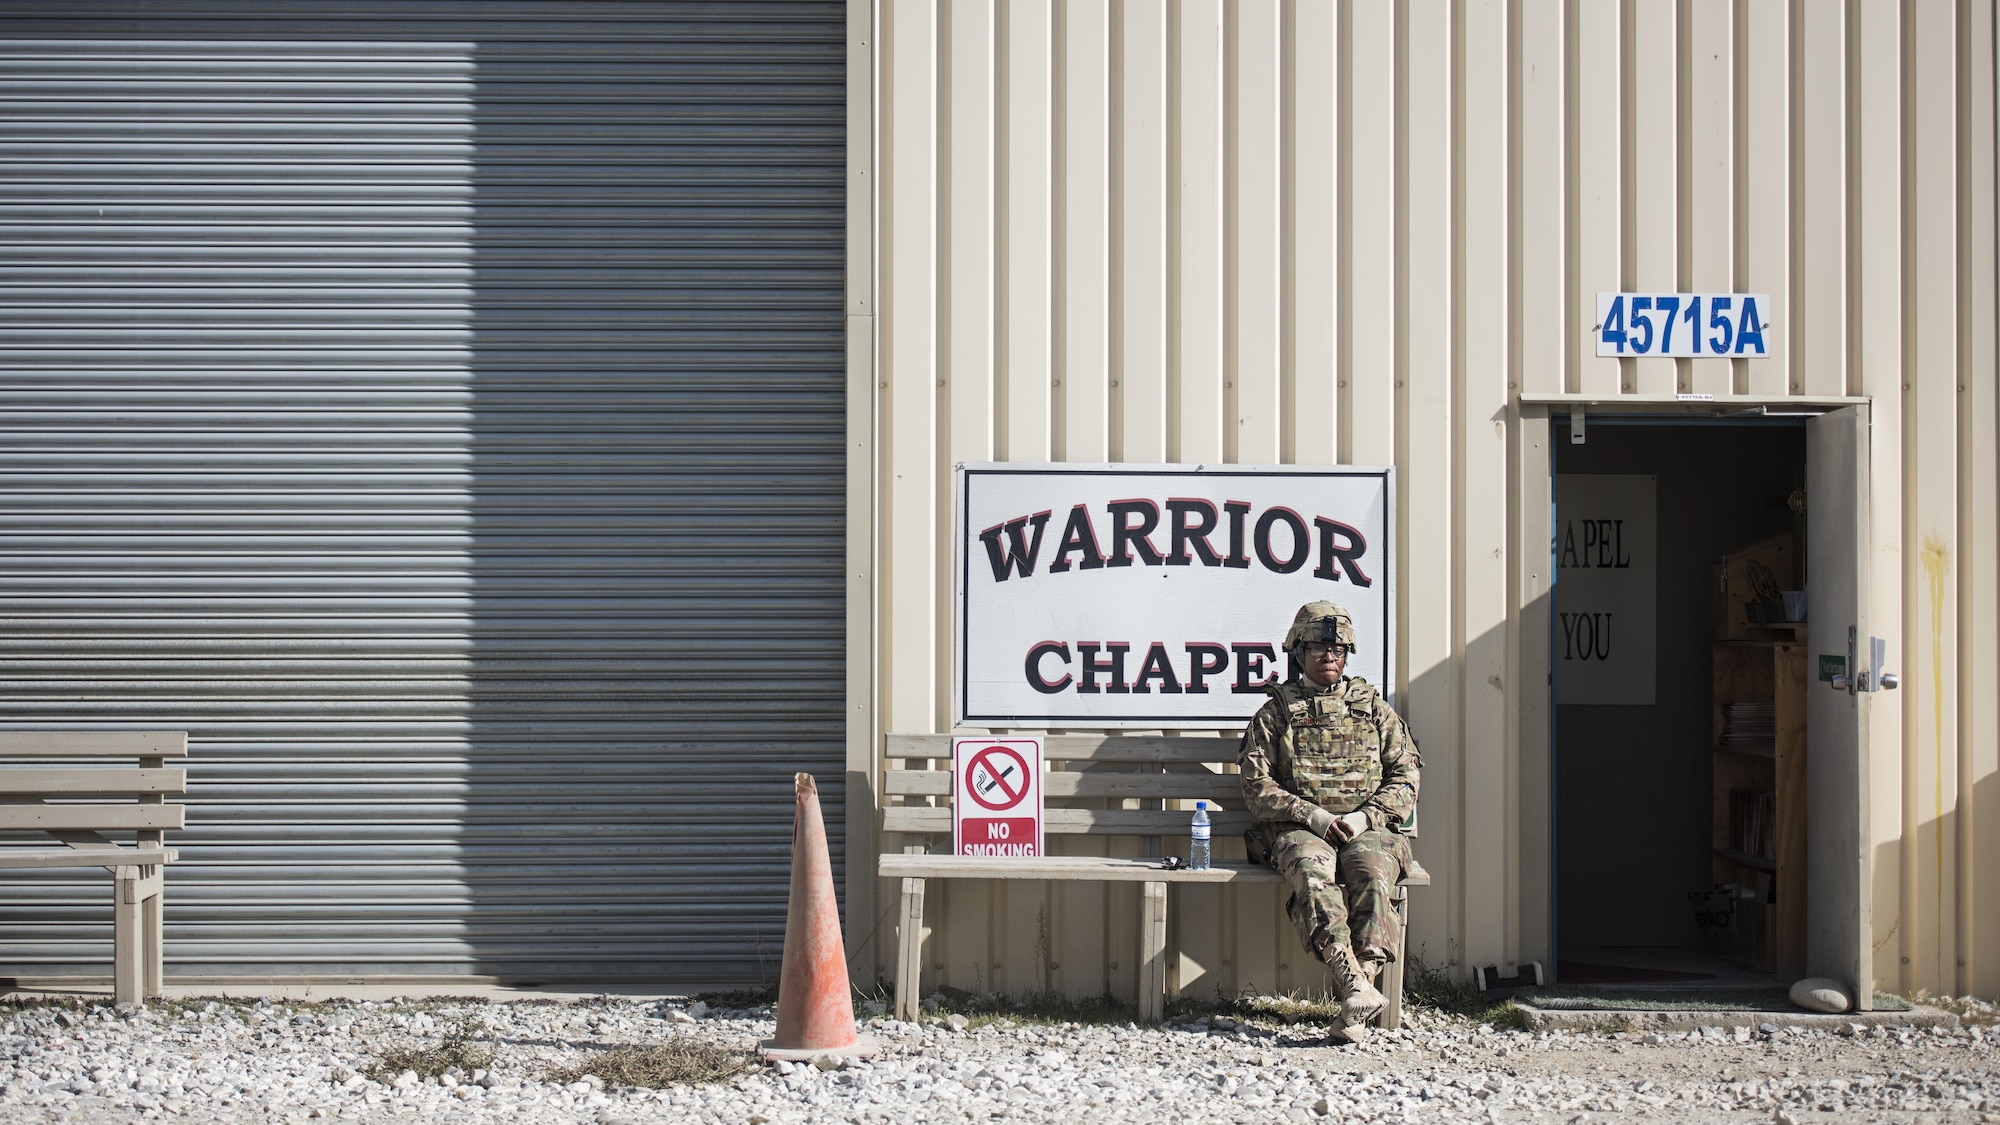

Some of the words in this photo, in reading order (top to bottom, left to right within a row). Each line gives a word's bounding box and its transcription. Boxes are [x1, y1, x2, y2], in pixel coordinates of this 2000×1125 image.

[1602, 296, 1765, 354] 45715A
[979, 497, 1373, 588] WARRIOR
[1556, 519, 1631, 569] APEL
[1559, 612, 1613, 661] YOU
[963, 843, 1035, 857] SMOKING
[987, 822, 1010, 840] NO
